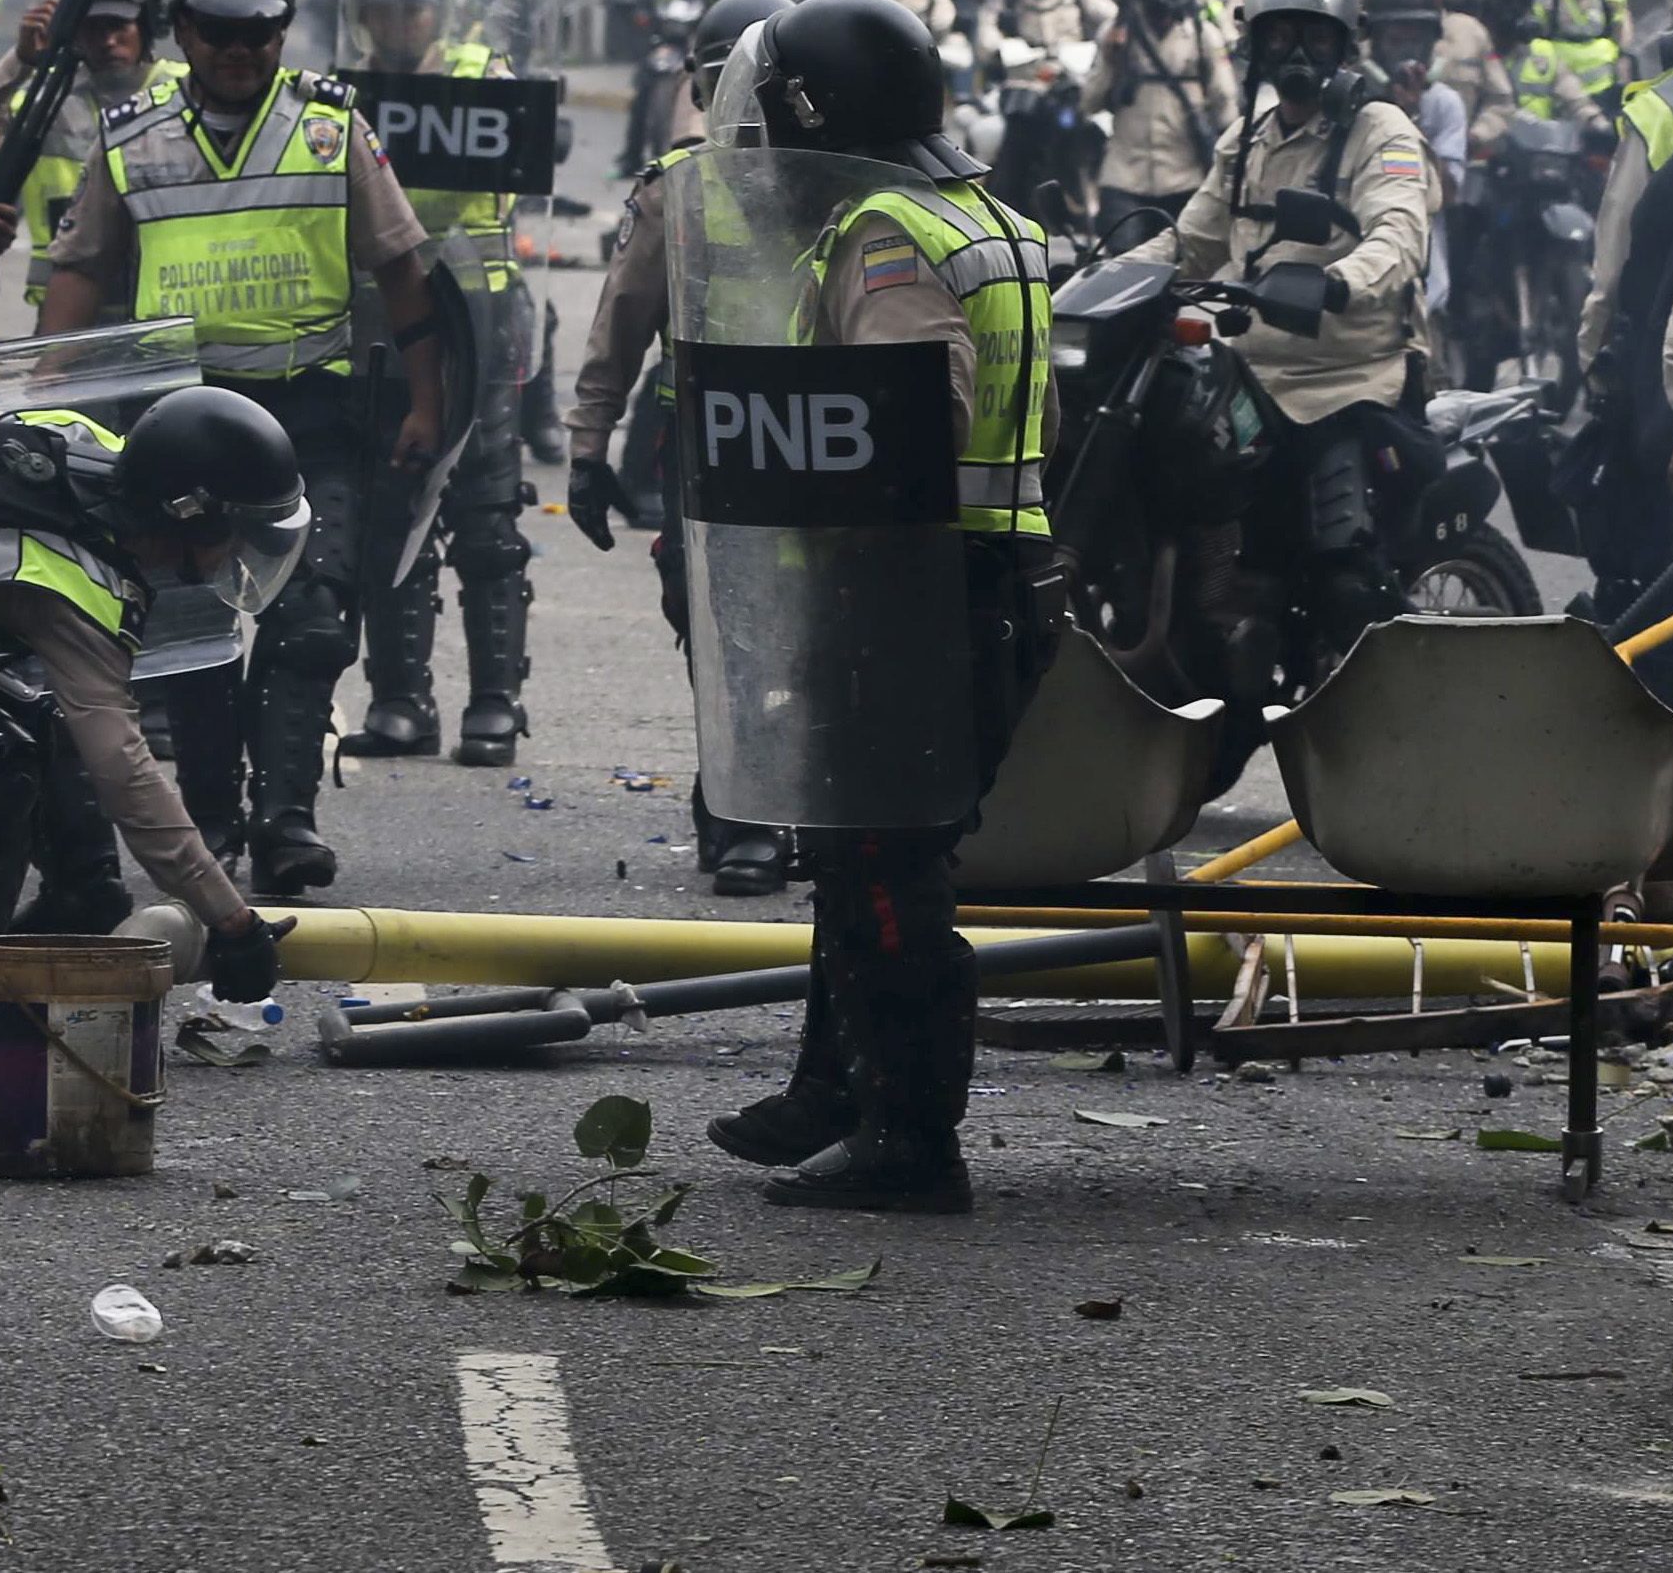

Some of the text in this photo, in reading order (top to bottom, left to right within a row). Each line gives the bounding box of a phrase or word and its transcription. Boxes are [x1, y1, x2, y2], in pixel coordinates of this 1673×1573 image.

[378, 101, 510, 159] PNB
[159, 252, 311, 290] POLICIA NACIONAL
[704, 390, 875, 471] PNB
